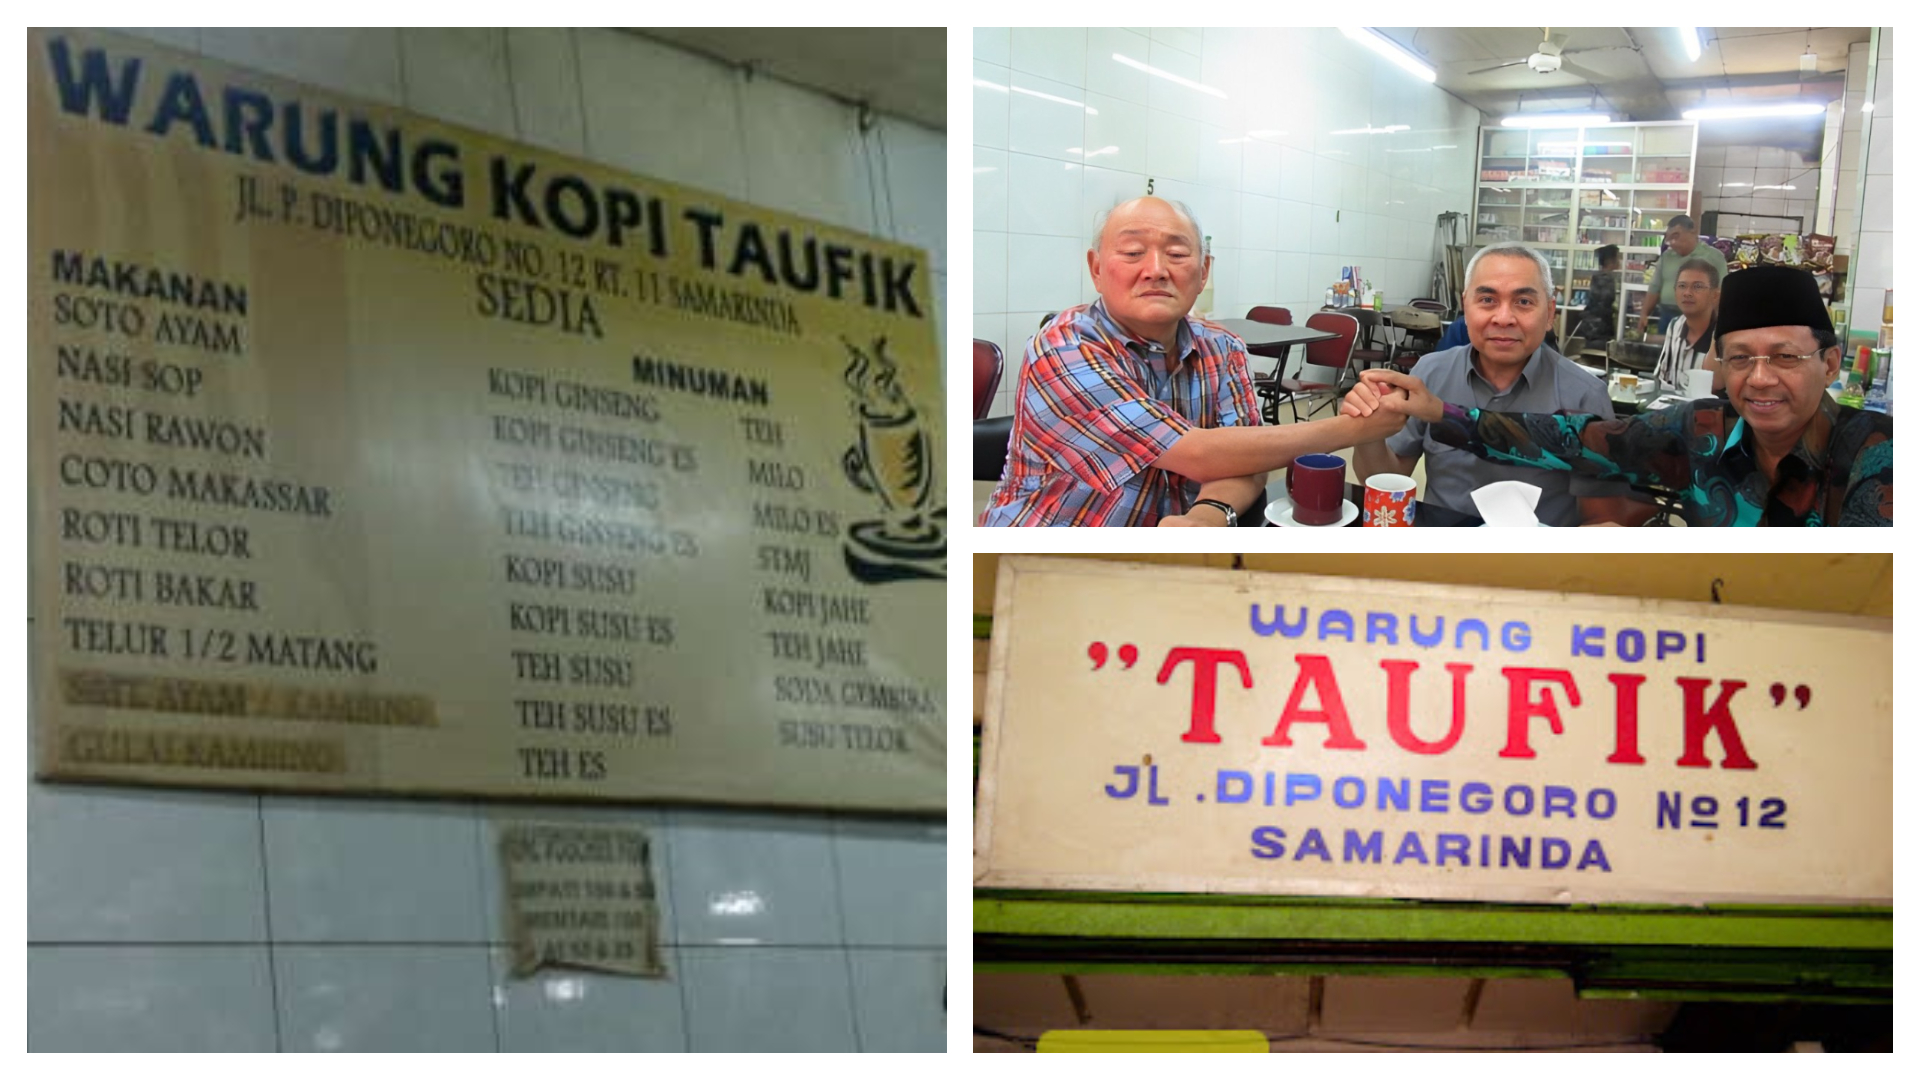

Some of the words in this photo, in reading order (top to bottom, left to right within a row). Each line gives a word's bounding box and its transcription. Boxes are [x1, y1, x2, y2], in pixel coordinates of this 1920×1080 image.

[47, 35, 465, 209] WARUNG
[490, 154, 667, 258] KOPI
[683, 209, 925, 319] TAUFIK
[1147, 178, 1154, 195] 5
[52, 249, 248, 317] MAKANAN
[312, 193, 497, 268] DIPONEGORO
[504, 239, 553, 280] NO.
[558, 250, 586, 290] 12
[635, 269, 662, 305] 11
[667, 276, 801, 336] SAMARINDA
[54, 294, 144, 337] SOTO
[156, 314, 245, 355] AYAM
[475, 269, 603, 339] SEDIA
[57, 347, 132, 389] NASI
[142, 360, 201, 397] SOP
[488, 367, 546, 404] KOPI
[556, 381, 660, 424] GINSENG
[632, 355, 768, 406] MINUMAN
[58, 401, 134, 440] NASI
[146, 412, 266, 459] RAWON
[492, 415, 551, 448] KOPI
[559, 425, 665, 466] GINSENG
[672, 444, 698, 472] ES
[739, 416, 784, 448] TEH
[61, 454, 157, 495] COTO
[167, 467, 333, 519] MAKASSAR
[748, 459, 804, 490] MILO
[63, 508, 141, 548] ROTI
[151, 517, 251, 559] TELOR
[752, 503, 811, 534] MILO
[816, 510, 840, 538] ES
[65, 561, 143, 600] ROTI
[155, 572, 259, 611] BAKAR
[505, 554, 564, 589] KOPI
[572, 561, 636, 595] SUSU
[757, 546, 810, 582] STMJ
[509, 603, 570, 636] KOPI
[576, 608, 641, 641] SUSU
[647, 615, 676, 645] ES
[764, 588, 815, 618] KOPI
[818, 594, 870, 626] JAHE
[64, 616, 168, 657] TELUR
[181, 627, 237, 663] 1/2
[247, 634, 378, 674] MATANG
[765, 630, 813, 661] TEH
[815, 636, 868, 669] JAHE
[1249, 603, 1533, 652] WARUNG
[1570, 624, 1706, 664] KOPI
[510, 651, 561, 681] TEH
[569, 655, 632, 687] SUSU
[774, 675, 834, 706] SODA
[514, 699, 565, 731] TEH
[573, 702, 637, 734] SUSU
[646, 705, 672, 736] ES
[778, 719, 834, 749] SUSU
[517, 747, 570, 778] TEH
[578, 750, 607, 780] ES
[1736, 796, 1787, 829] 12
[1250, 826, 1612, 873] SAMARINDA
